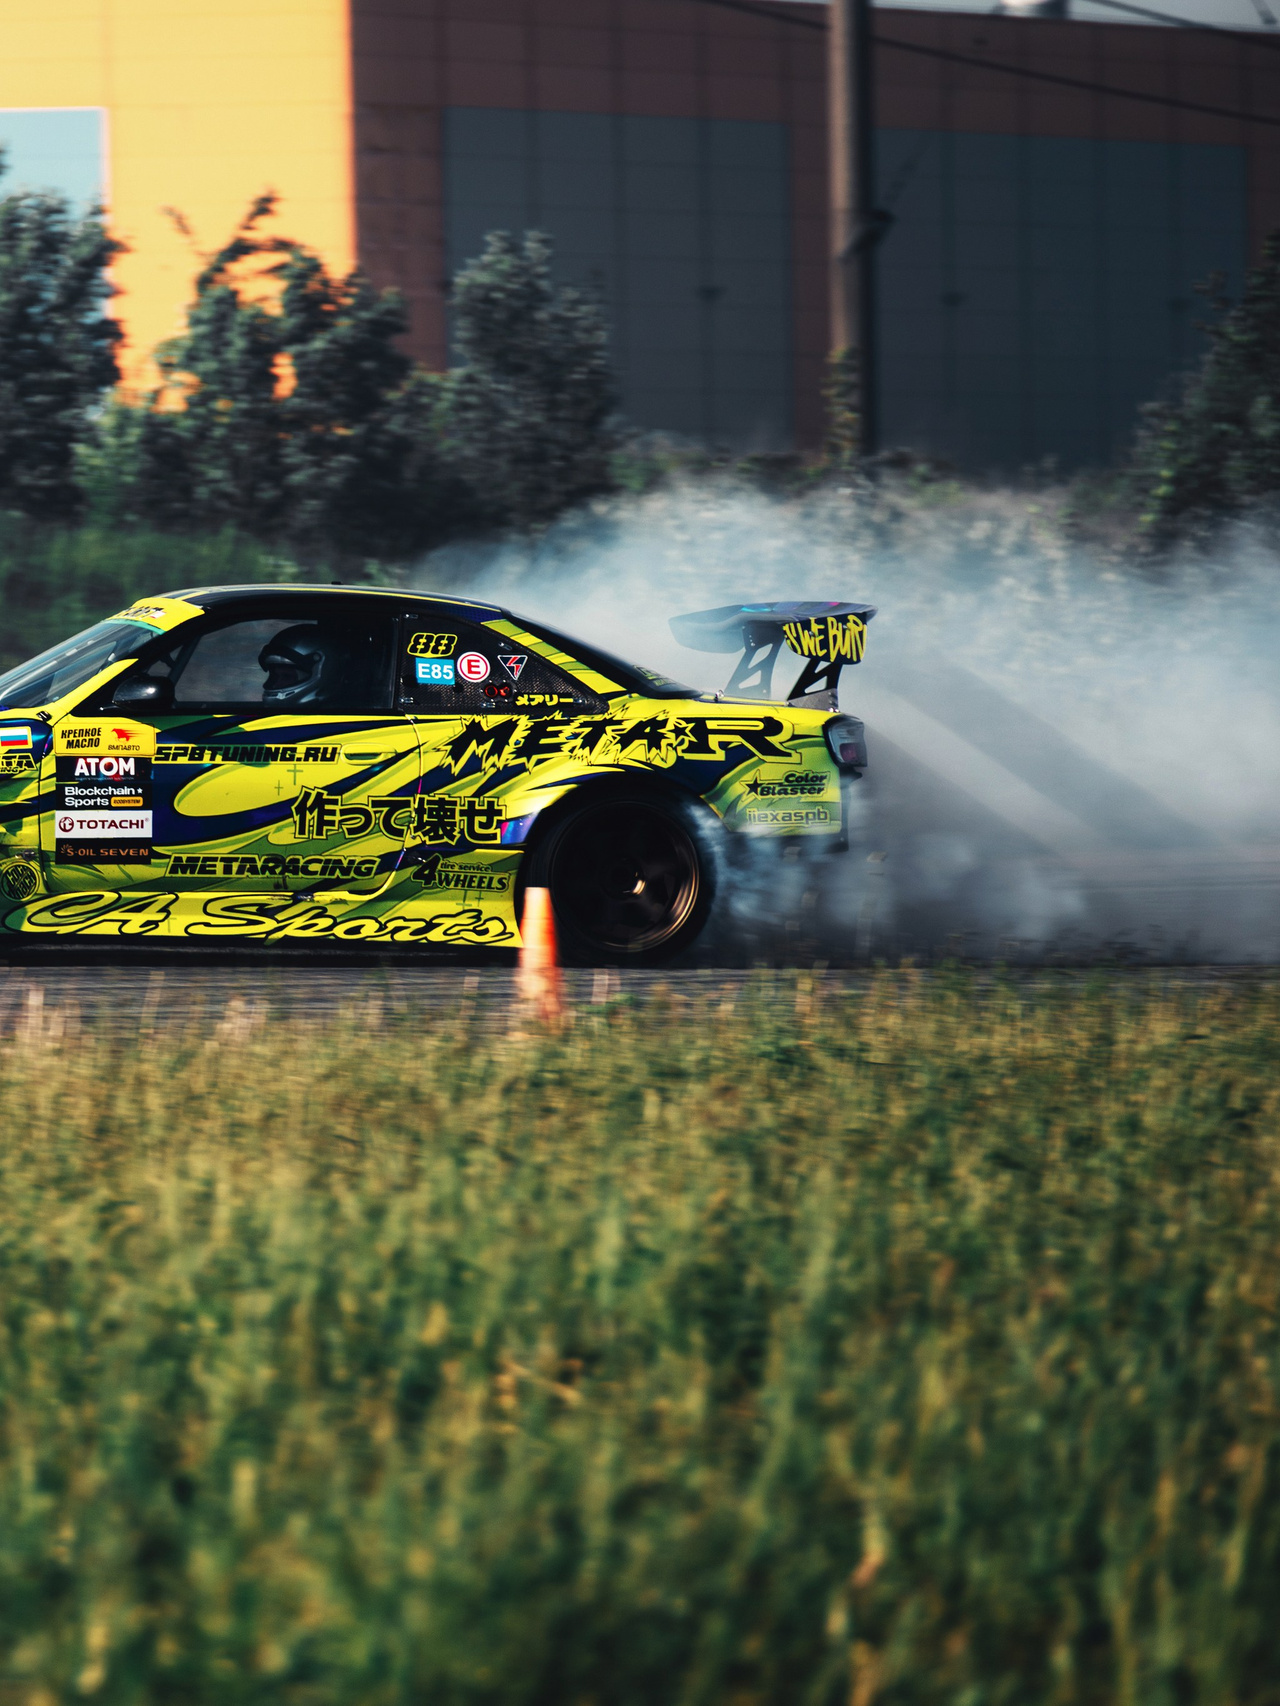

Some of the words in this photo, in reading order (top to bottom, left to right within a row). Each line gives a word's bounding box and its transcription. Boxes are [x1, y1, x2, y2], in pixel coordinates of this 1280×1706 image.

[407, 632, 458, 658] 88
[417, 662, 454, 680] E85
[466, 658, 482, 675] E
[515, 694, 574, 706] メアリー
[61, 727, 102, 739] КРЕПКОЕ
[66, 738, 100, 749] МАСЛО
[154, 746, 338, 762] SPBTUNING.RU
[74, 757, 135, 776] ATOM
[784, 772, 827, 784] Color
[65, 786, 135, 796] Blockchain
[759, 785, 824, 796] Blaster
[65, 797, 109, 808] Sports
[294, 788, 506, 844] 作って壊せ
[76, 819, 145, 829] TOTACHI
[100, 848, 149, 856] SEVEN
[168, 855, 376, 877] METARACING
[440, 862, 456, 870] tire
[458, 863, 491, 872] service
[184, 893, 516, 945] Sports
